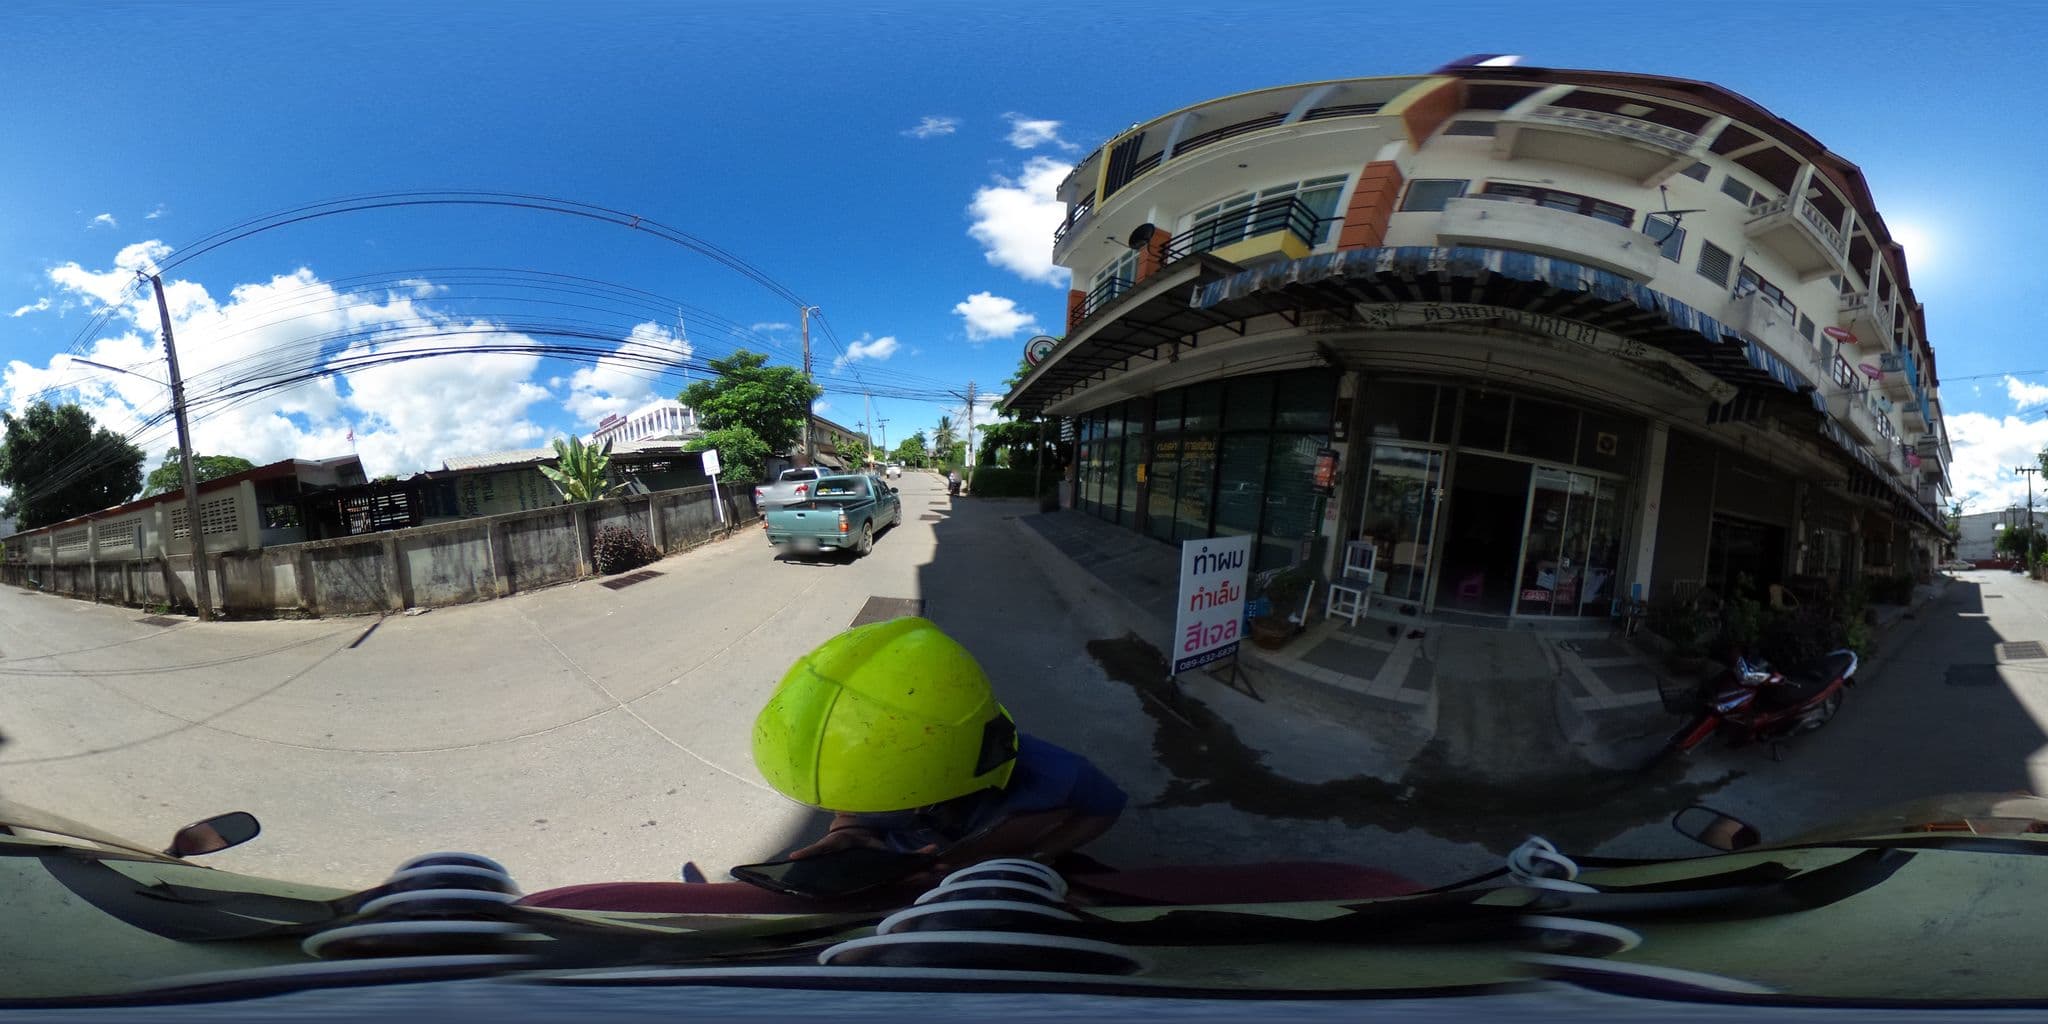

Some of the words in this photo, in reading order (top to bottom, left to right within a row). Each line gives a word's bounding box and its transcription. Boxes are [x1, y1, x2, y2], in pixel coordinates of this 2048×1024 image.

[1193, 546, 1244, 575] ทำผม
[1190, 580, 1240, 611] ทำเล็บ
[1184, 619, 1237, 652] สีเจล
